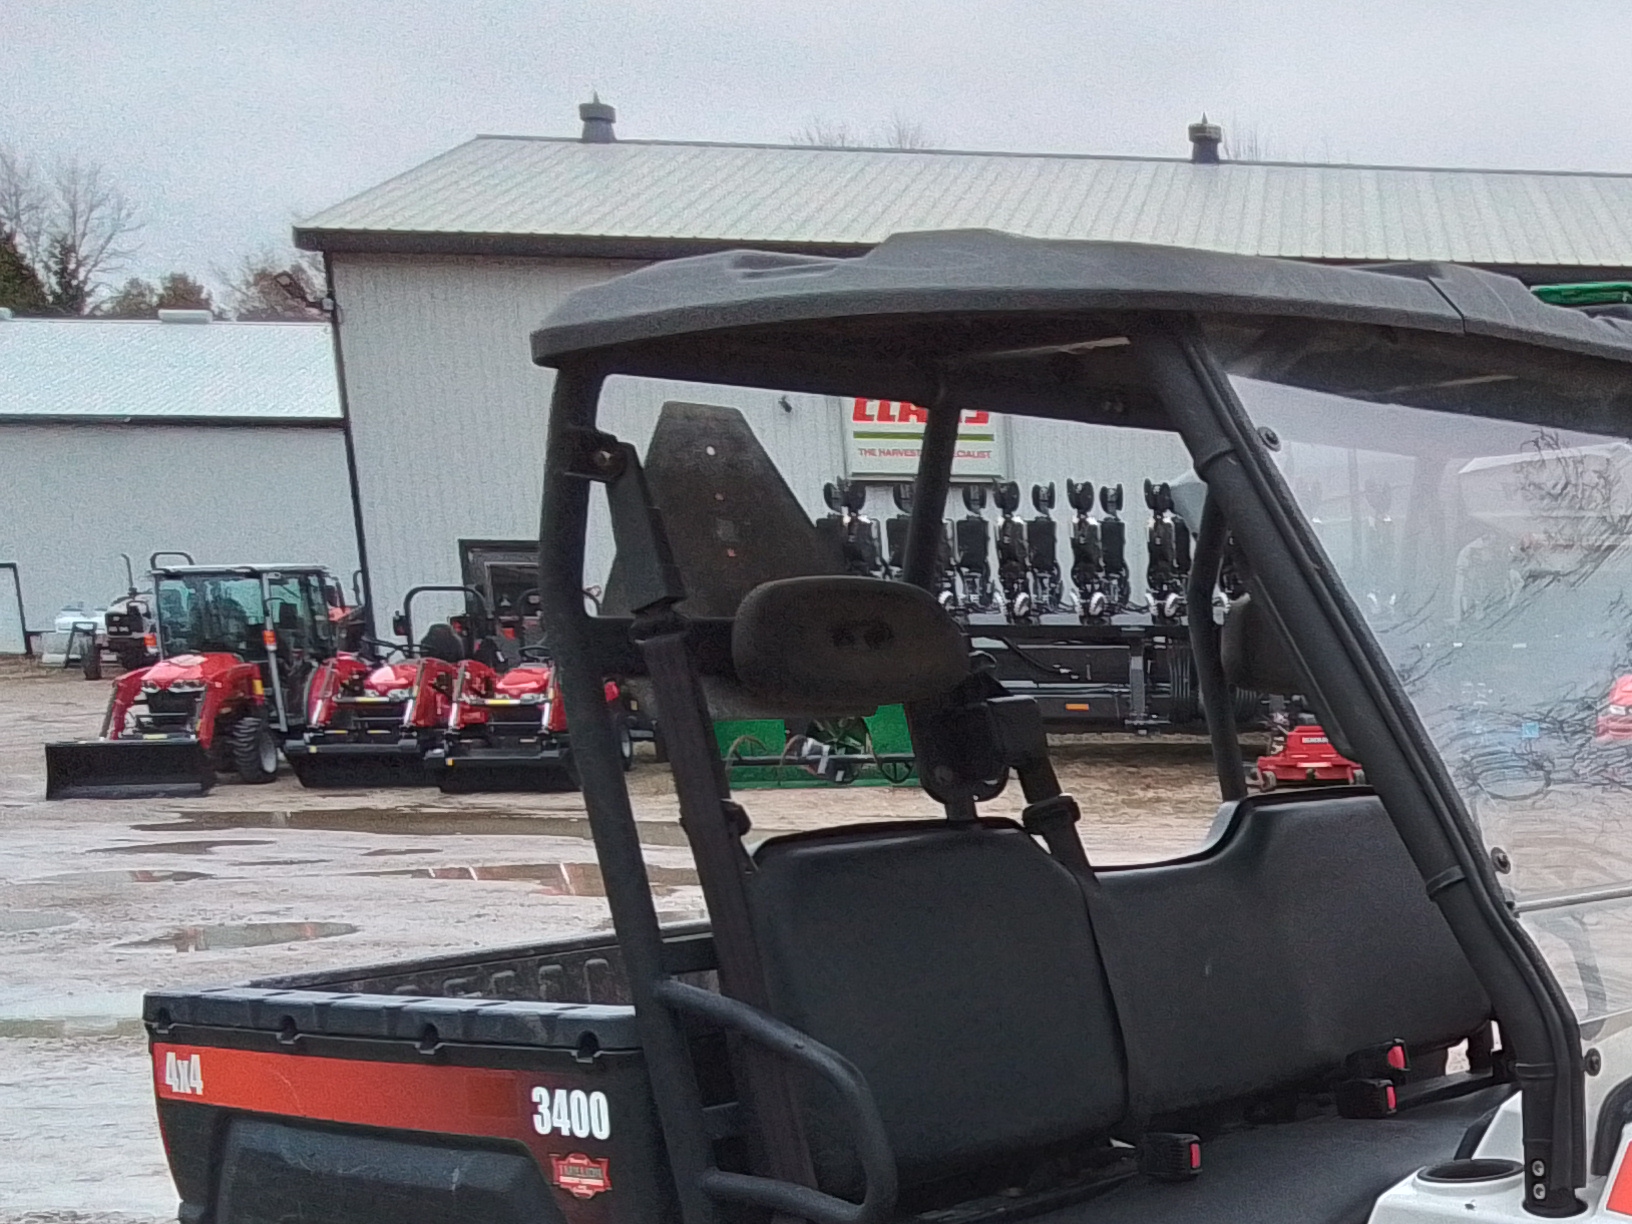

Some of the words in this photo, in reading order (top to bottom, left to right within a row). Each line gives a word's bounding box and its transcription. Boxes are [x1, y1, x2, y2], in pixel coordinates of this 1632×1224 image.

[858, 447, 877, 457] THE
[164, 1051, 204, 1096] 4x4
[531, 1086, 611, 1140] 3400
